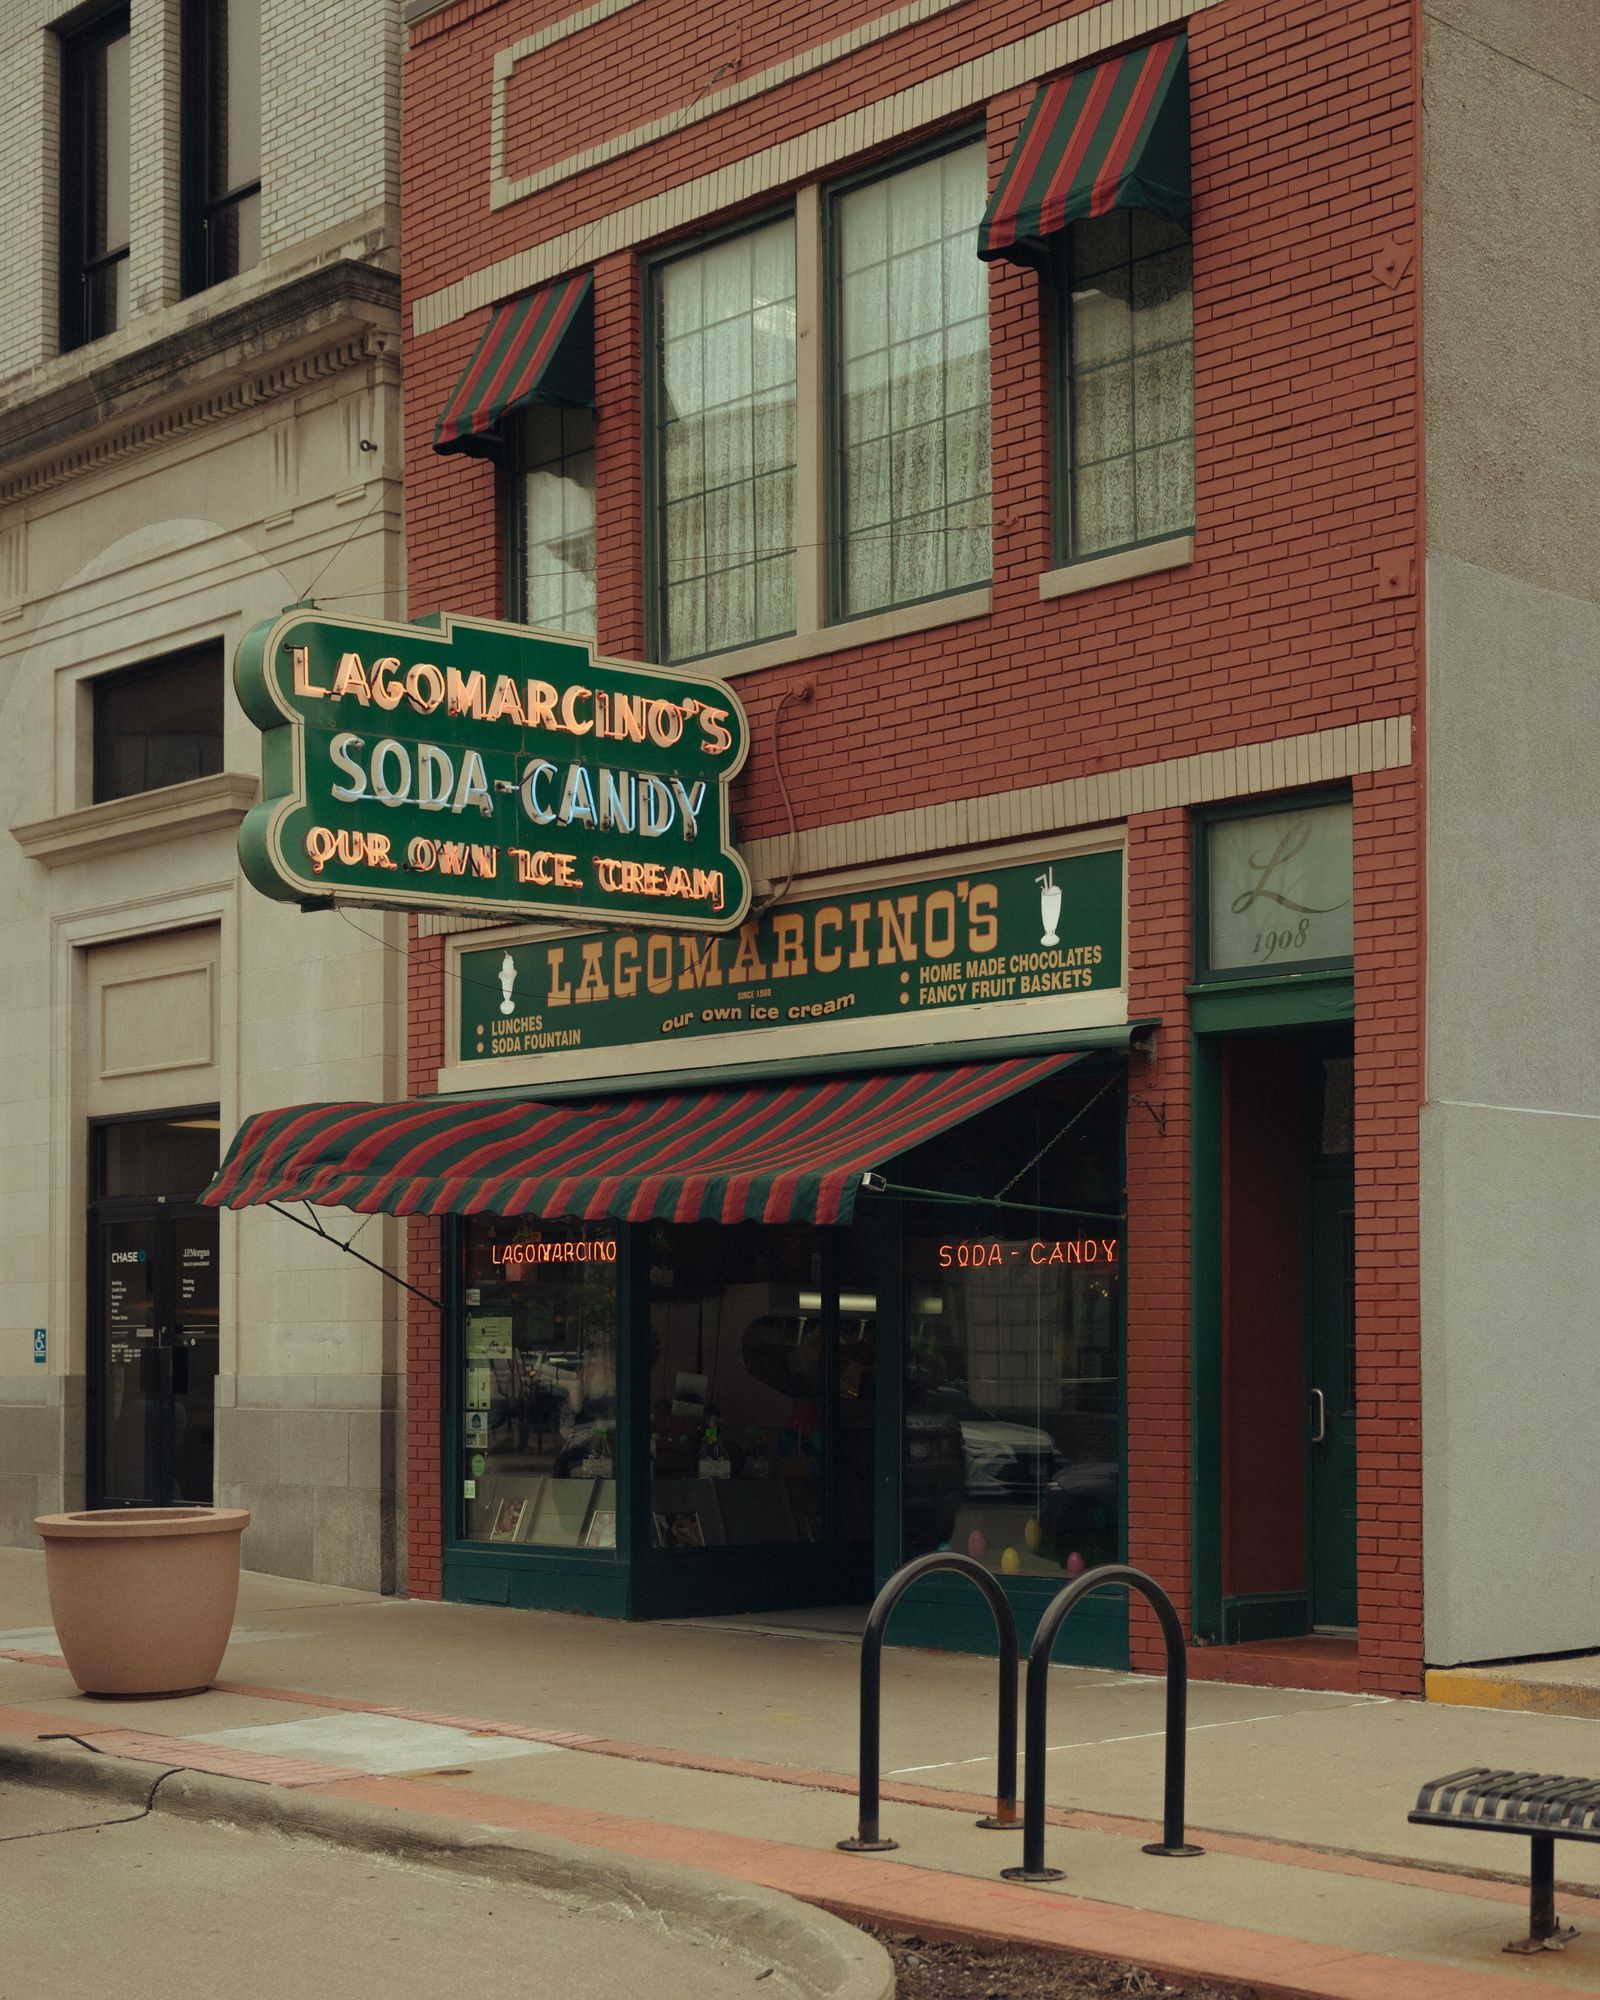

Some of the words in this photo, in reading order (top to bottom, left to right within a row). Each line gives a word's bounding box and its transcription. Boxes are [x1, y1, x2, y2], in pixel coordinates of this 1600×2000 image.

[293, 646, 733, 755] LAGOMARCINO'S
[306, 827, 394, 872] OUR
[407, 837, 499, 880] OWN
[514, 849, 580, 888] ICE
[597, 857, 724, 907] CREAM
[547, 880, 998, 1008] LAGOMARCINO'S
[1252, 918, 1309, 963] 1908
[919, 963, 962, 984] HOME
[966, 958, 1005, 978] MADE
[1009, 945, 1102, 973] CHOCOLATES
[737, 990, 754, 1001] SINCE
[919, 983, 967, 1006] FANCY
[971, 977, 1016, 1000] FRUIT
[1020, 968, 1092, 994] BASKETS
[491, 1015, 543, 1037] LUNCHES
[660, 1011, 694, 1034] our
[702, 1007, 742, 1022] own
[750, 1004, 779, 1021] ice
[787, 992, 855, 1020] cream
[491, 1036, 521, 1055] SODA
[523, 1029, 581, 1050] FOUNTAIN
[111, 1252, 138, 1263] CHASE
[492, 1241, 617, 1264] LAGOMARCINO
[939, 1243, 1003, 1267] SODA
[1030, 1239, 1118, 1265] CANDY
